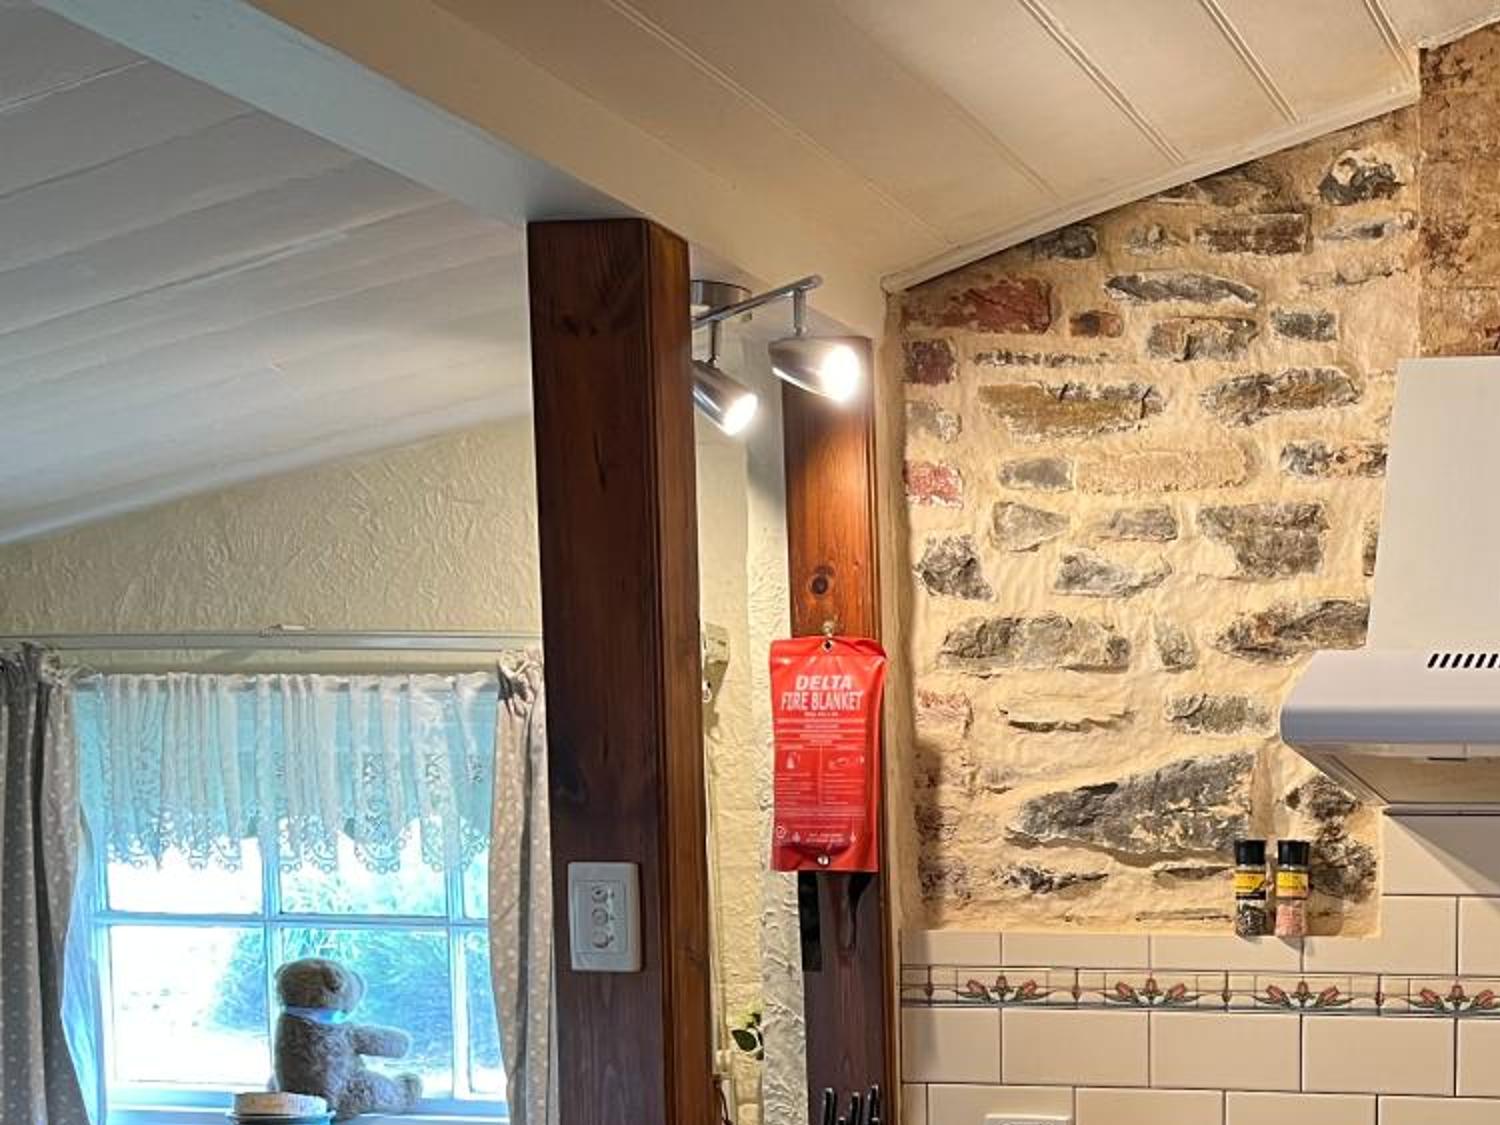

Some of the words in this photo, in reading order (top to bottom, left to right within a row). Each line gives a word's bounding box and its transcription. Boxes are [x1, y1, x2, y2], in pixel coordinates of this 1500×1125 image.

[795, 674, 853, 691] DELTA
[781, 691, 809, 712] FIRE
[811, 689, 864, 711] BLANKET
